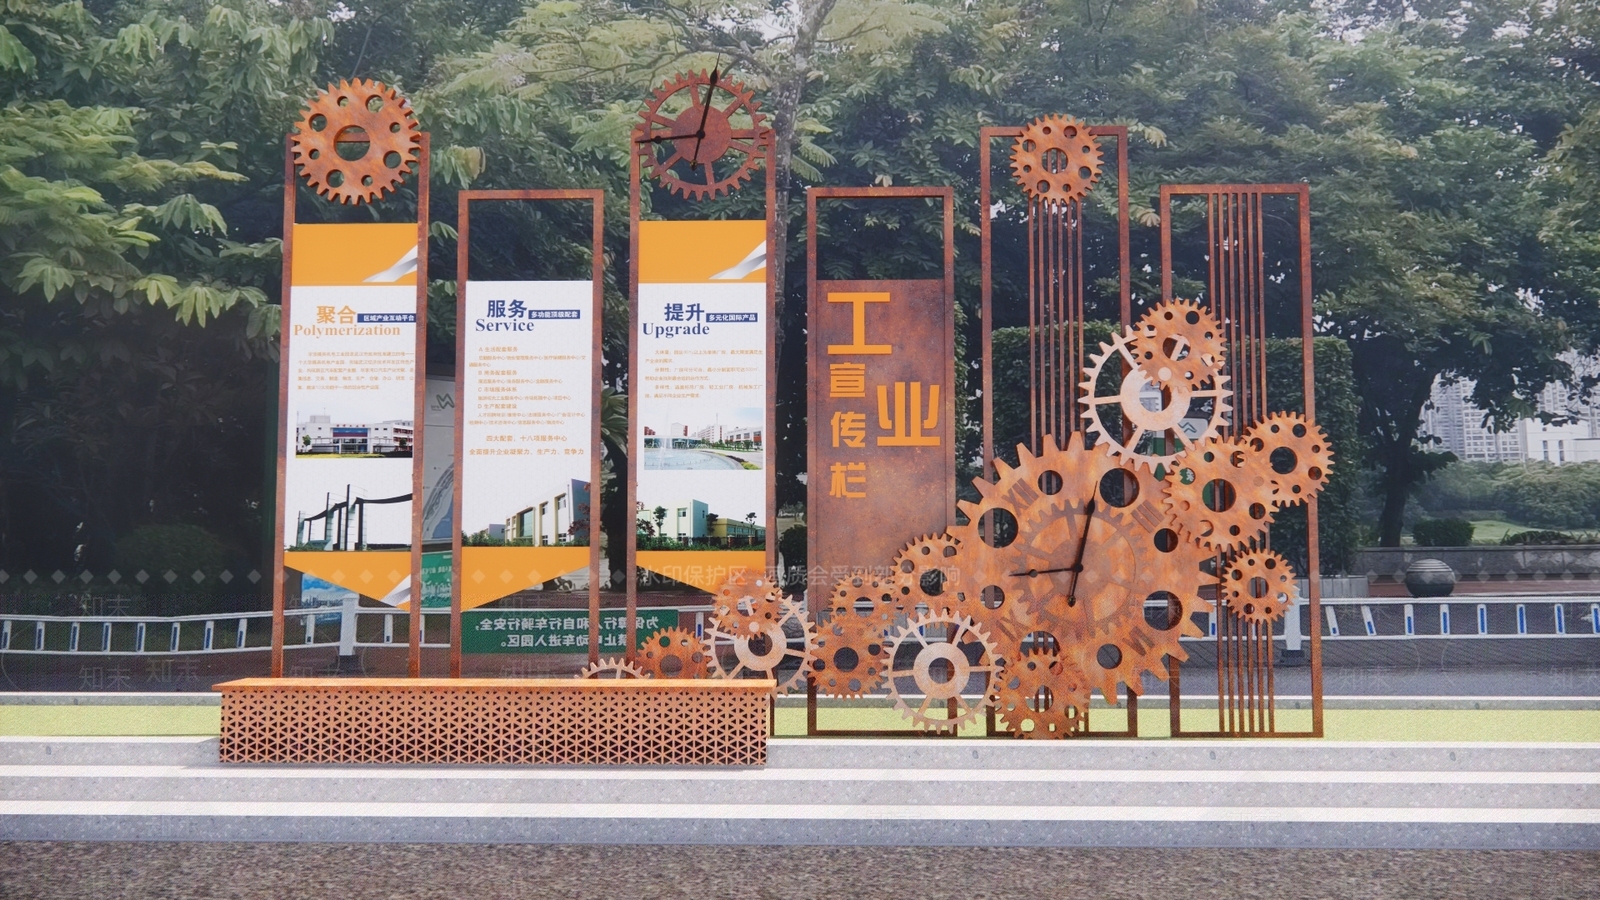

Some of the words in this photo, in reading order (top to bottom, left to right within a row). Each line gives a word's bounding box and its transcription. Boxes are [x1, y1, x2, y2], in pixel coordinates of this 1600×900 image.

[316, 305, 356, 324] 聚合
[487, 299, 527, 318] 服务
[664, 303, 705, 322] 提升
[363, 314, 415, 322] 区域产业互动平台
[475, 319, 535, 332] Service
[709, 314, 756, 322] 多元化国际产品
[293, 324, 401, 339] Polymerization
[642, 323, 710, 339] Upgrade
[827, 292, 893, 355] 工
[876, 382, 941, 447] 业
[829, 362, 867, 498] 宣传栏
